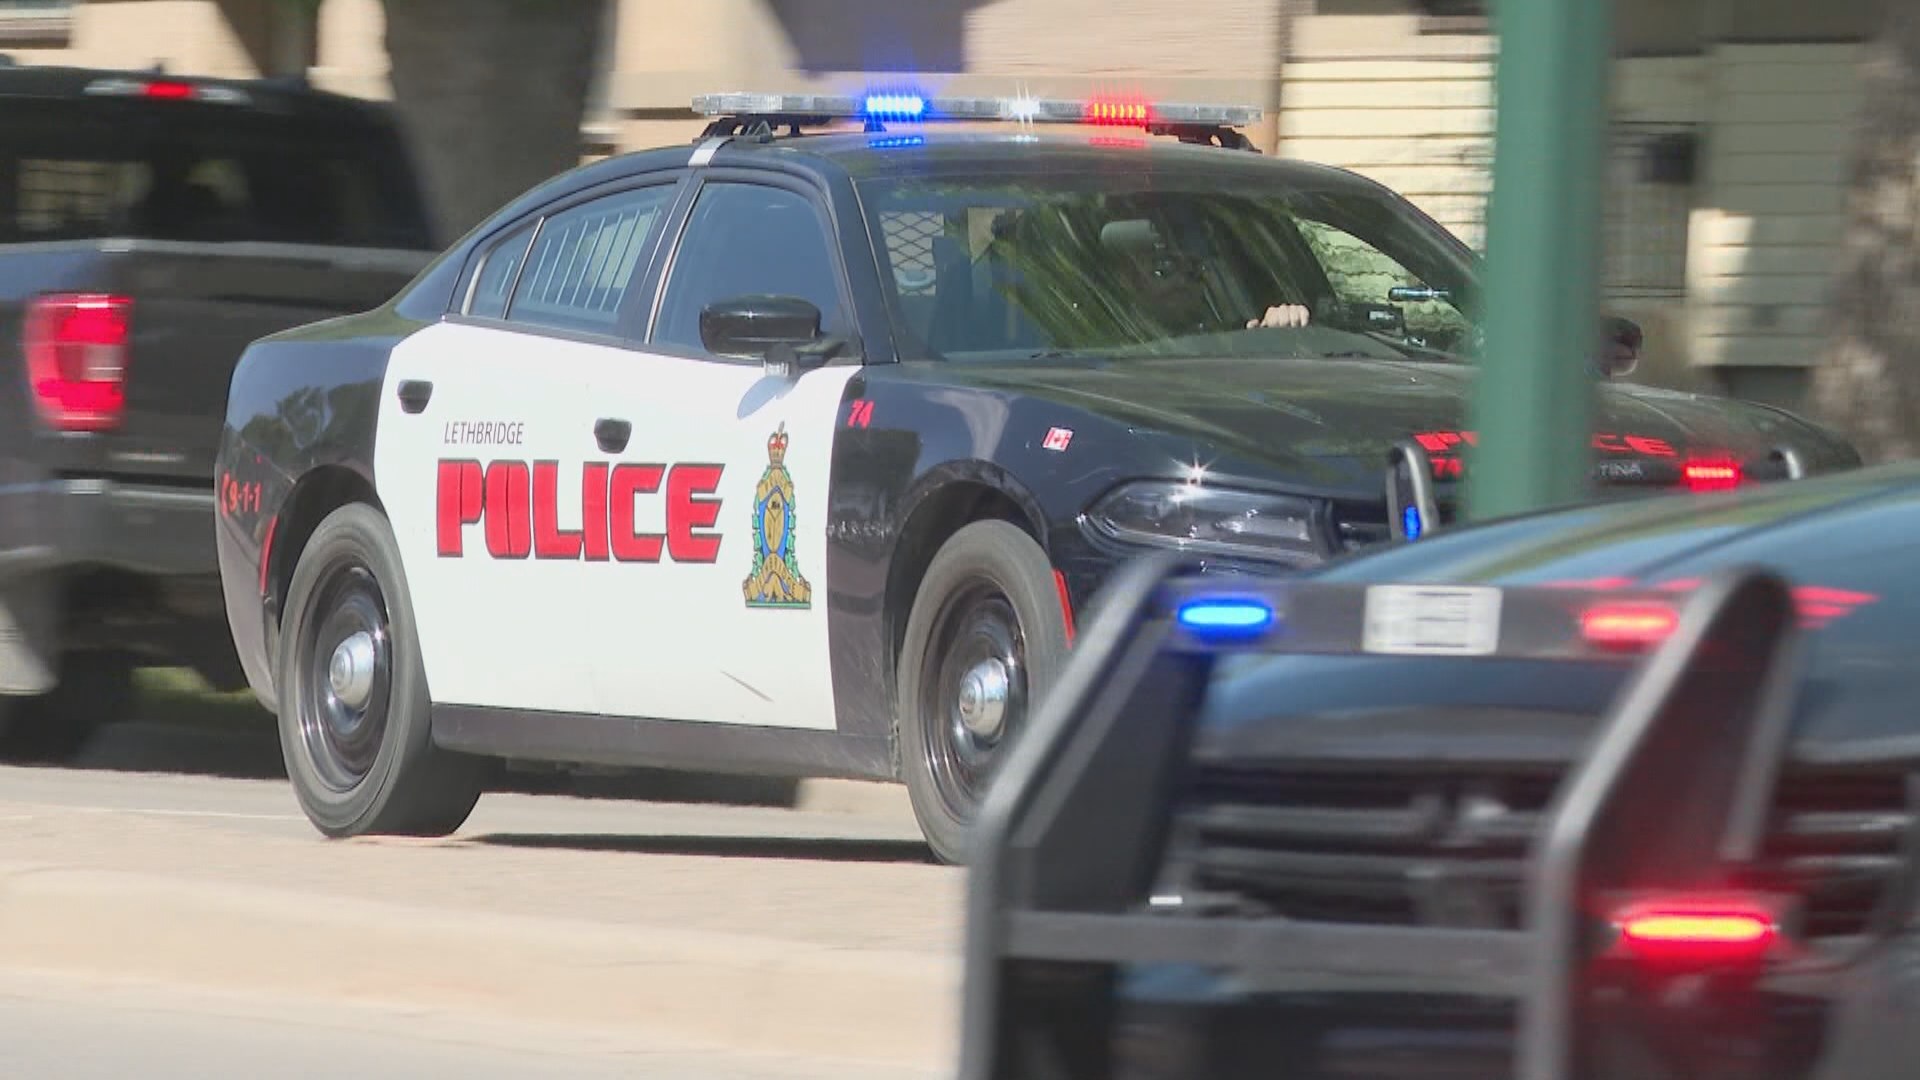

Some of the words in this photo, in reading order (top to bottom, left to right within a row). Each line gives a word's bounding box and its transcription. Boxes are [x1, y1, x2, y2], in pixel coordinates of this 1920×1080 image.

[848, 400, 874, 427] 74
[444, 421, 524, 444] LETHBRIDGE
[436, 458, 726, 563] POLICE
